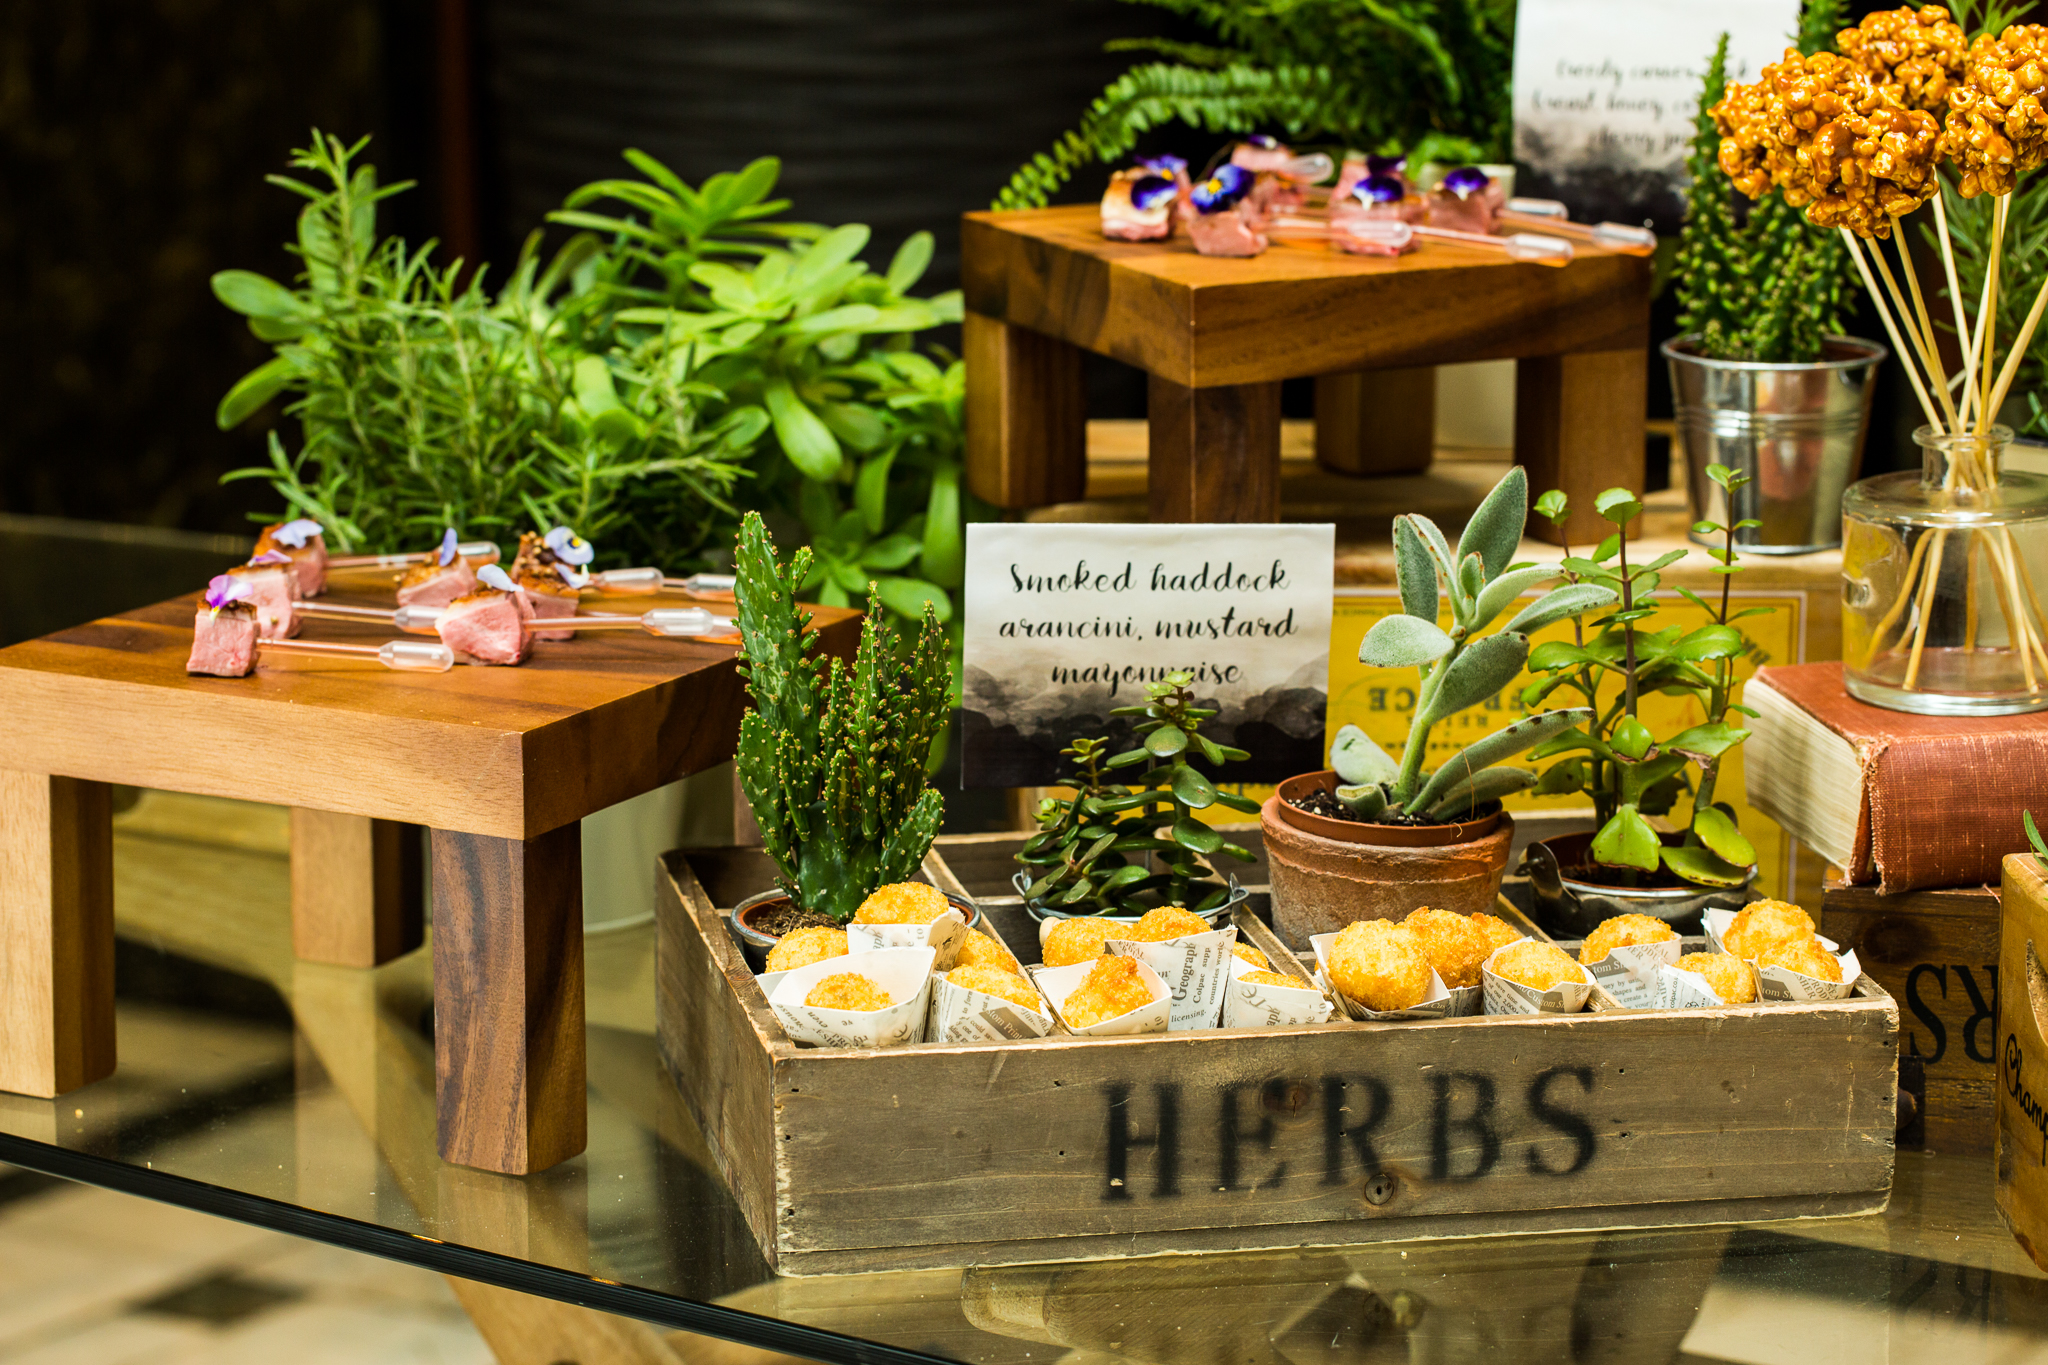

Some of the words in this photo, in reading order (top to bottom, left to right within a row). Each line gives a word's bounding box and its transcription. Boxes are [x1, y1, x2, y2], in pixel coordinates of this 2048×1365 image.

[1010, 559, 1137, 593] Smoked
[1149, 558, 1292, 593] haddock
[999, 616, 1144, 642] arancini,
[1155, 605, 1298, 640] mustard
[1051, 661, 1244, 698] mayonnaise
[1192, 973, 1207, 1004] Colpac
[1209, 967, 1221, 1005] countries
[1100, 1066, 1598, 1201] HERBS
